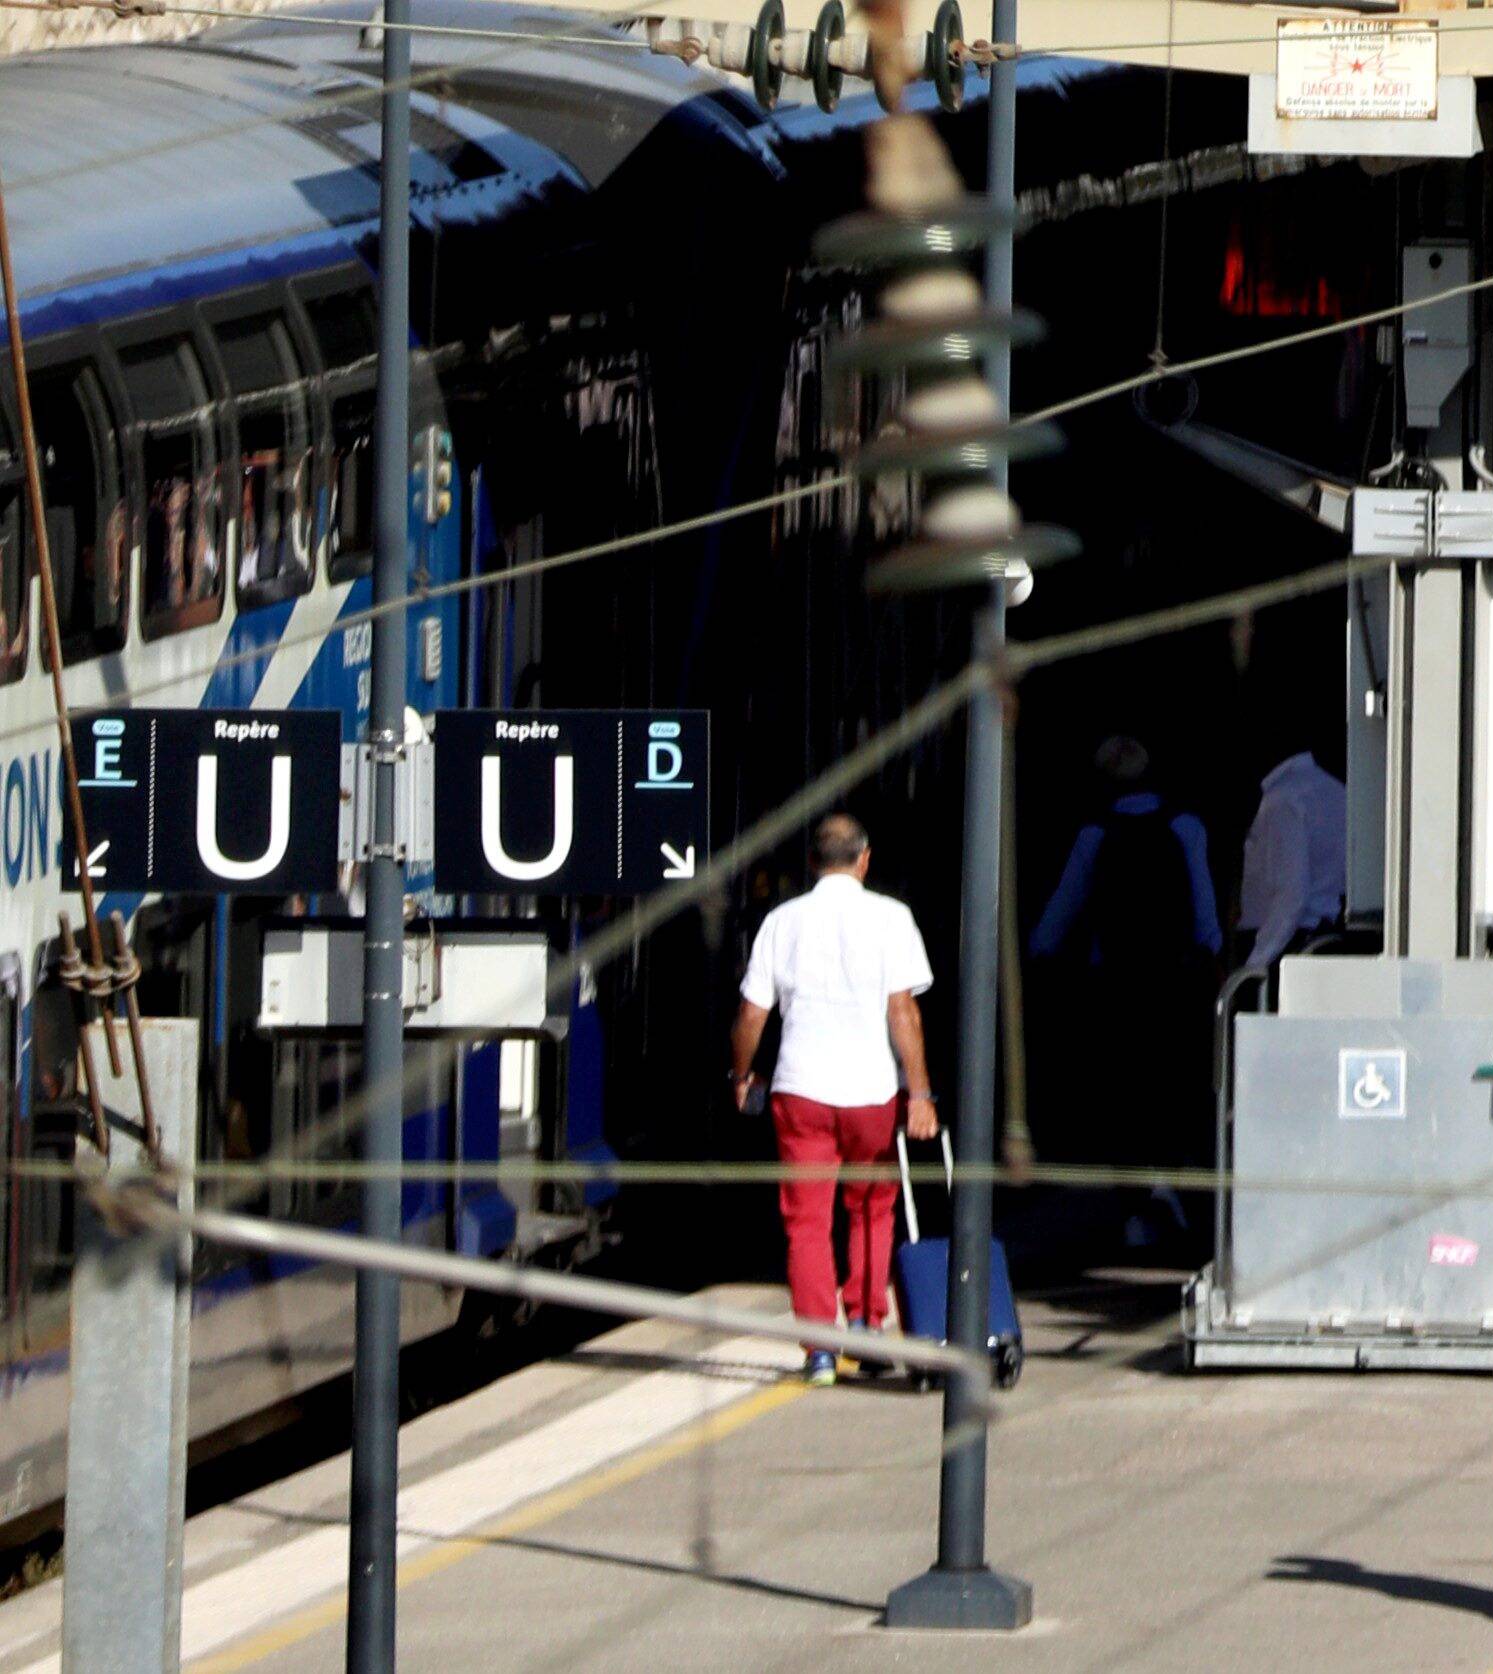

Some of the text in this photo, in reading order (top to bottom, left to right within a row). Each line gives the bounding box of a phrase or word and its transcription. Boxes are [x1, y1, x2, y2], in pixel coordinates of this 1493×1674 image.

[1322, 22, 1394, 32] ATTENTION
[1300, 82, 1354, 96] DANGER
[1374, 82, 1413, 96] MORT
[214, 719, 280, 743] Repère
[495, 719, 559, 742] Repère
[94, 739, 122, 780] E
[648, 740, 683, 782] D
[196, 754, 292, 881] U
[481, 754, 573, 881] U
